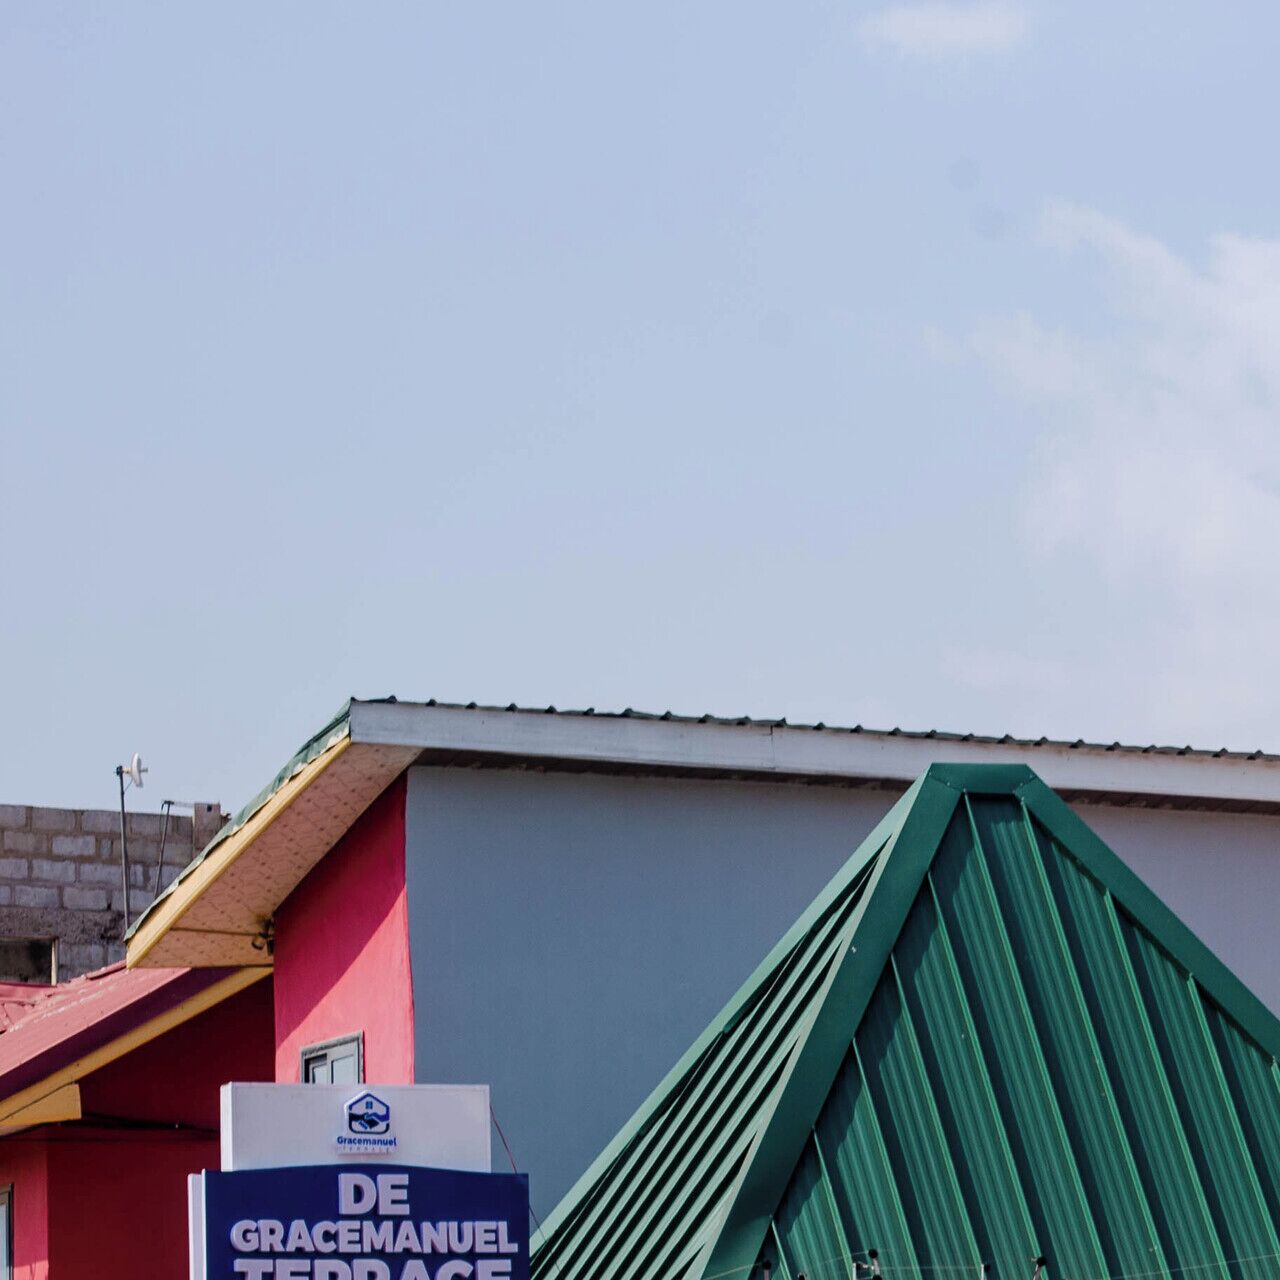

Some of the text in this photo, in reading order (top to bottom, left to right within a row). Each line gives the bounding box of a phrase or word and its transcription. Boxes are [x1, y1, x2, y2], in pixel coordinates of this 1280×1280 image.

[337, 1136, 397, 1147] Gracemanuel
[338, 1173, 410, 1216] DE
[230, 1219, 518, 1254] GRACEMANUEL
